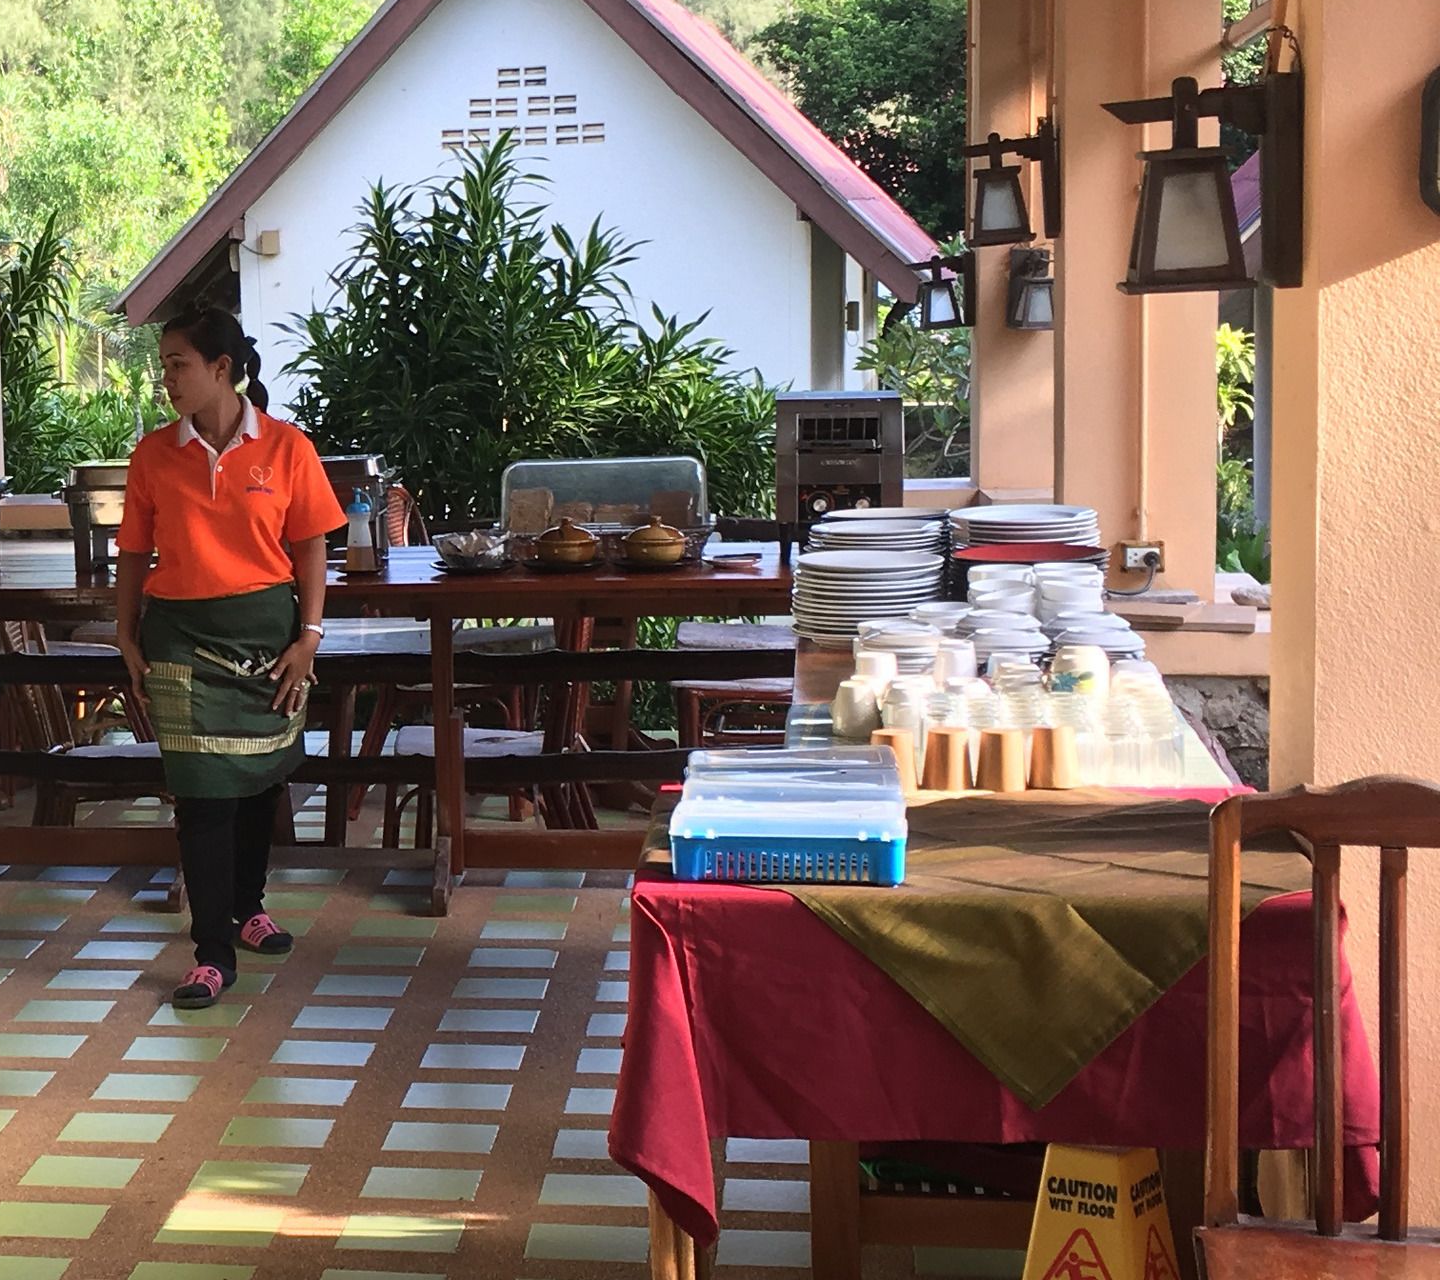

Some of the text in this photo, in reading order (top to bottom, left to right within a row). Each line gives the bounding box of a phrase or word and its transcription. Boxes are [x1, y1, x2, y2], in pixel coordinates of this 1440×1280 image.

[1047, 1176, 1117, 1204] CAUTION
[1049, 1197, 1115, 1219] WET FLOOR
